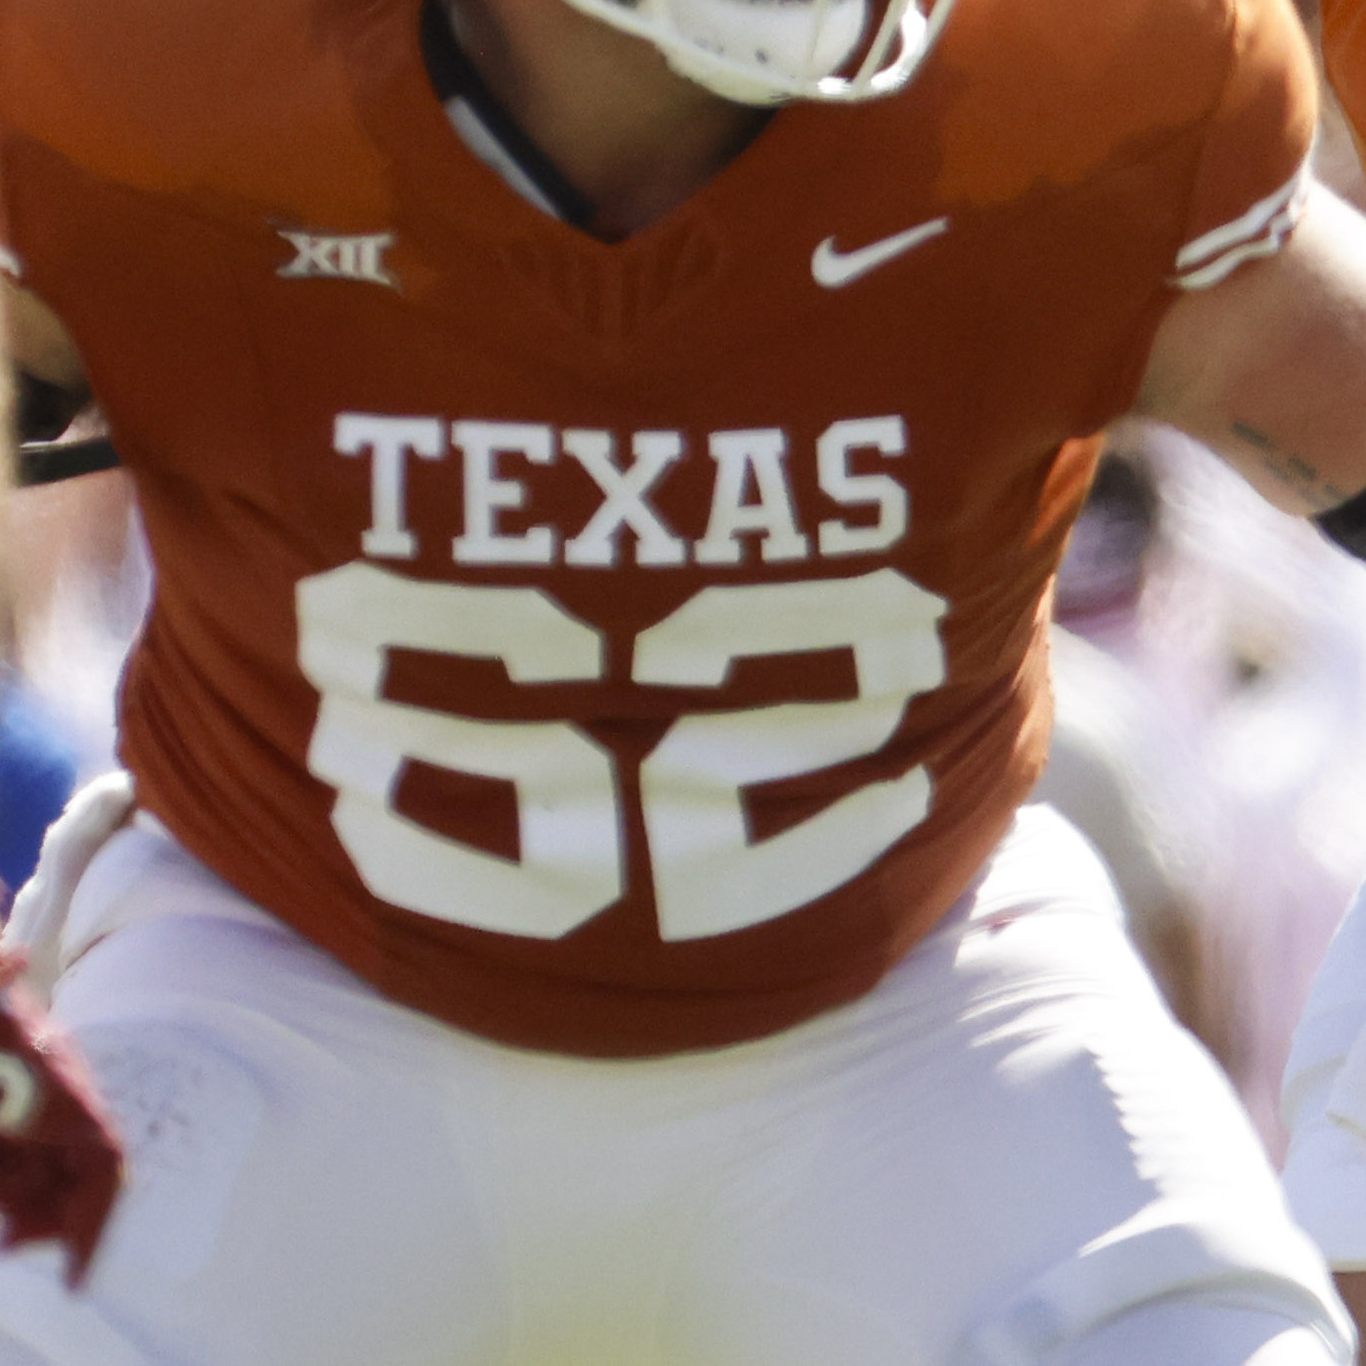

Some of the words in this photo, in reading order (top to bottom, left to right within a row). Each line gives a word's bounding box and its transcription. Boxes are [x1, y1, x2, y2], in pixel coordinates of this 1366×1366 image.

[275, 230, 397, 289] XII
[332, 411, 909, 568] TEXAS
[295, 560, 949, 943] 62
